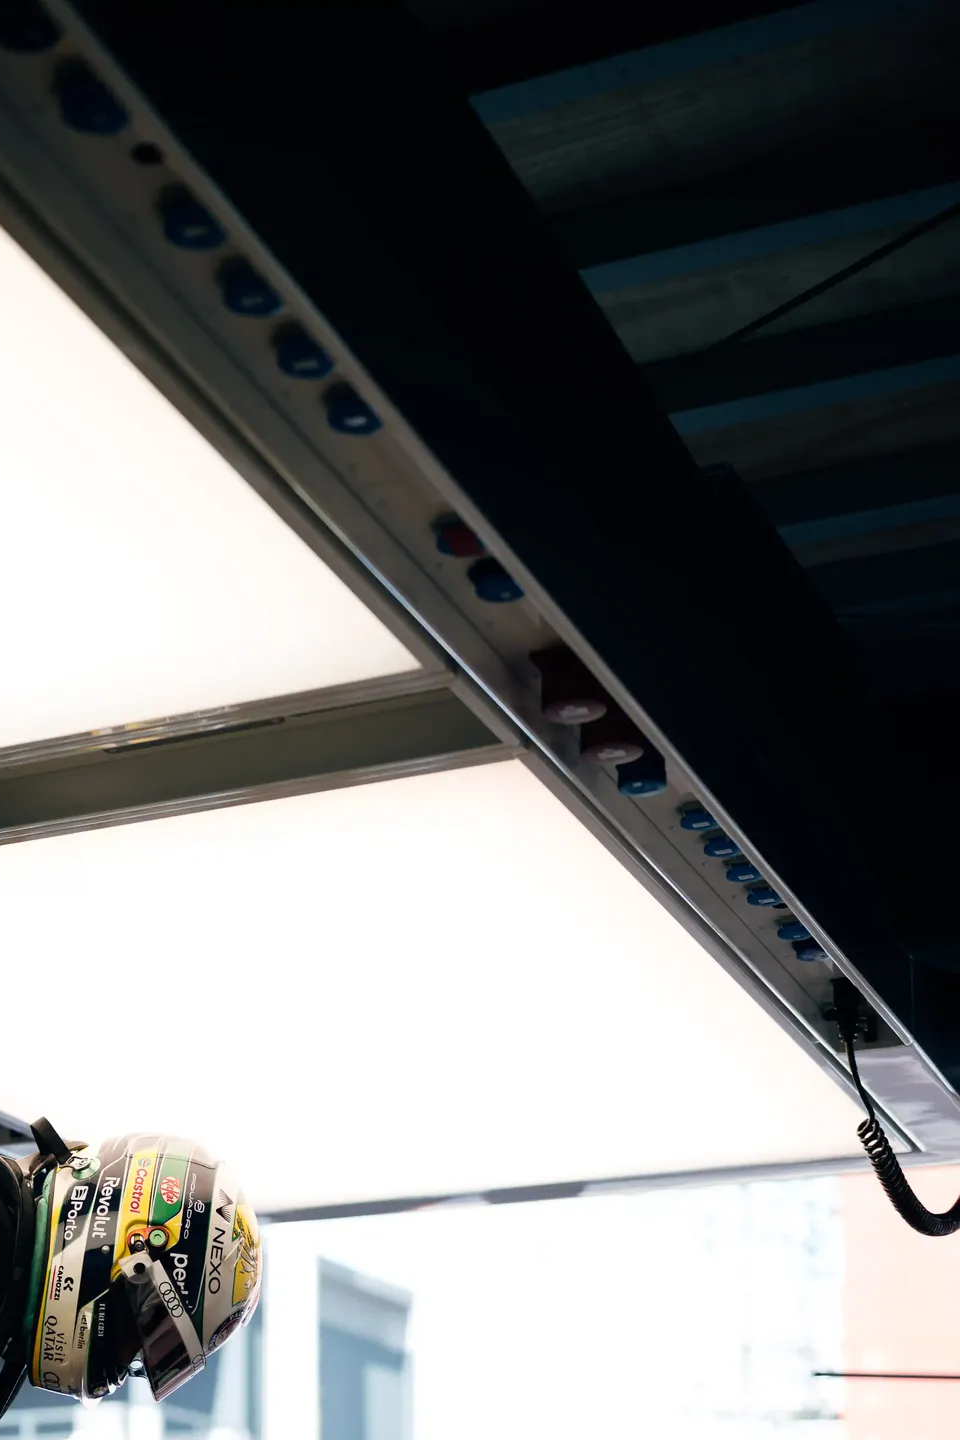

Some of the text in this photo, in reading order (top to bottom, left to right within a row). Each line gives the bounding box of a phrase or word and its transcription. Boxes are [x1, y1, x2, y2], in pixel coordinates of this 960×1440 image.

[91, 1176, 120, 1239] Revolut
[130, 1168, 148, 1214] Castrol
[183, 1172, 197, 1240] PIQUADRO
[64, 1201, 84, 1241] Porto
[53, 1265, 64, 1301] CAMOZZI
[208, 1226, 226, 1294] NEXO
[43, 1315, 58, 1362] QATAR
[53, 1332, 67, 1364] visit
